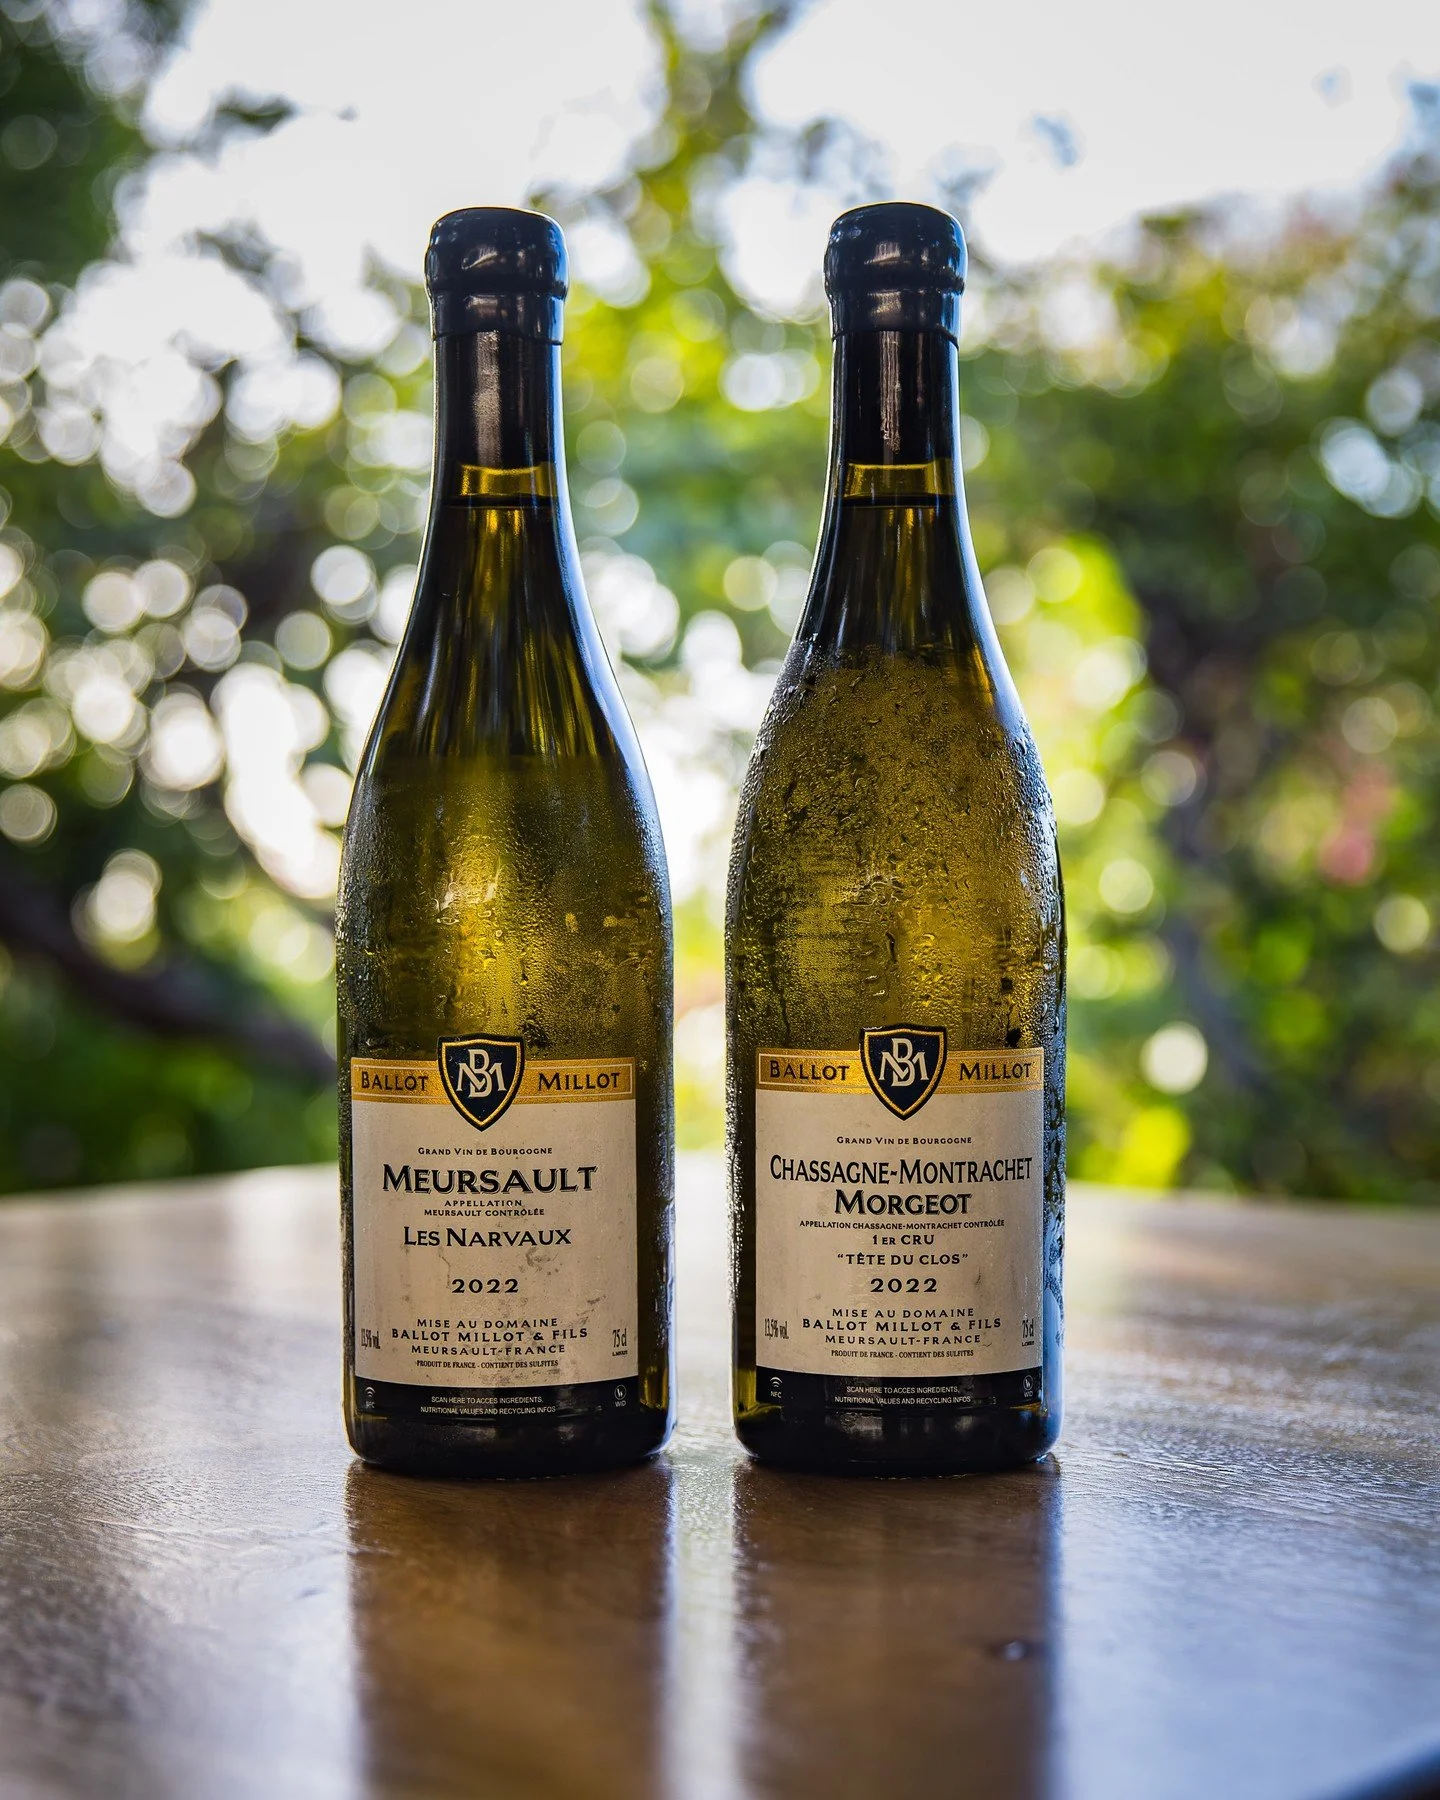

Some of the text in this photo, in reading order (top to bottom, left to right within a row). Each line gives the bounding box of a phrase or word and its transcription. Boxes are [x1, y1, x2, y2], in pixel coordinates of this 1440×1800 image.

[770, 1060, 850, 1081] BALLOT
[959, 1063, 1031, 1081] MILLOT
[361, 1070, 429, 1092] BALLOT
[538, 1072, 620, 1092] MILLOT
[836, 1136, 872, 1145] GRAND
[875, 1137, 895, 1145] VIN
[913, 1136, 972, 1145] BOURGOGNE
[418, 1147, 451, 1156] GRAND
[491, 1148, 553, 1156] BOURGOGNE
[770, 1155, 1032, 1184] CHASSAGNE-MONTRACHET
[382, 1163, 597, 1195] MEURSAULT
[835, 1190, 972, 1215] MORGEOT
[424, 1207, 545, 1217] MEURSAULT CONTRÔLÉE
[799, 1219, 1005, 1230] APPELLATION CHASSAGNE-MONTRACHET CONTRÔLÉE
[403, 1226, 572, 1247] LES NARVAUX
[872, 1234, 935, 1245] 1 ER CRU
[890, 1254, 914, 1265] DU
[451, 1278, 519, 1294] 2022
[870, 1277, 938, 1293] 2022
[832, 1308, 974, 1318] MISE AU DOMAINE
[417, 1318, 558, 1329] MISE AU DOMAINE
[802, 1318, 1002, 1332] BALLOT MILLOT & FILS
[392, 1328, 588, 1342] BALLOT MILLOT & FILS
[612, 1329, 620, 1348] 75
[825, 1334, 981, 1346] MEURSAULT-FRANCE
[411, 1345, 566, 1356] MEURSAULT-FRANCE
[417, 1360, 442, 1368] PRODUIT
[529, 1360, 558, 1368] SULFITES
[835, 1396, 874, 1404] NUTRITIONAL
[421, 1406, 459, 1414] NUTRITIONAL
